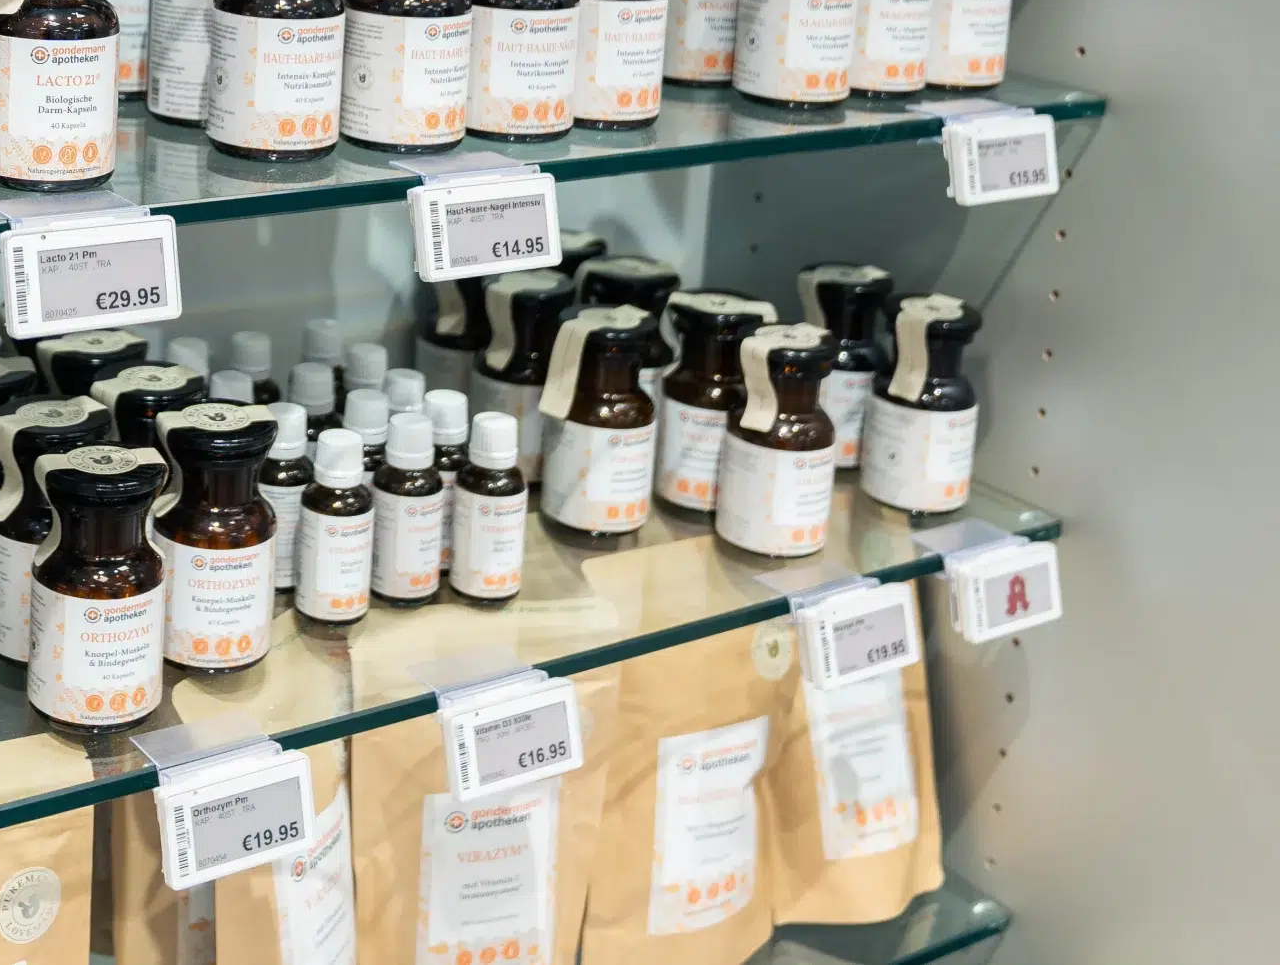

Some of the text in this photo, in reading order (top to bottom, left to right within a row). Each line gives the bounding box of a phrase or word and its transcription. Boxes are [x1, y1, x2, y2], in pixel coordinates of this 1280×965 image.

[297, 34, 335, 44] apotheken
[52, 45, 106, 57] gondermann
[52, 53, 99, 65] apotheken
[516, 68, 565, 77] Nutrikosmetik
[36, 75, 84, 87] LACTO
[283, 80, 332, 90] Nutrikosmetik
[45, 93, 93, 106] Biologische
[37, 103, 98, 116] Darm-Kapseln
[61, 121, 87, 131] Kapseln
[1009, 168, 1046, 186] €15.95
[512, 199, 541, 210] Intensiv
[492, 236, 544, 258] €14.95
[40, 250, 98, 264] Lacto 21 Pm
[96, 286, 161, 311] €29.95
[209, 552, 260, 566] gondermann
[208, 560, 252, 574] apotheken
[103, 598, 153, 617] gondermann
[103, 608, 147, 624] apotheken
[84, 642, 151, 660] Knorpel-Muskeln
[867, 639, 906, 664] €19.95
[89, 653, 147, 669] & Bindegewebe
[518, 740, 567, 768] €16.95
[192, 796, 248, 818] Orthozym Pm
[471, 812, 531, 831] apotheken
[242, 820, 299, 852] €19.95
